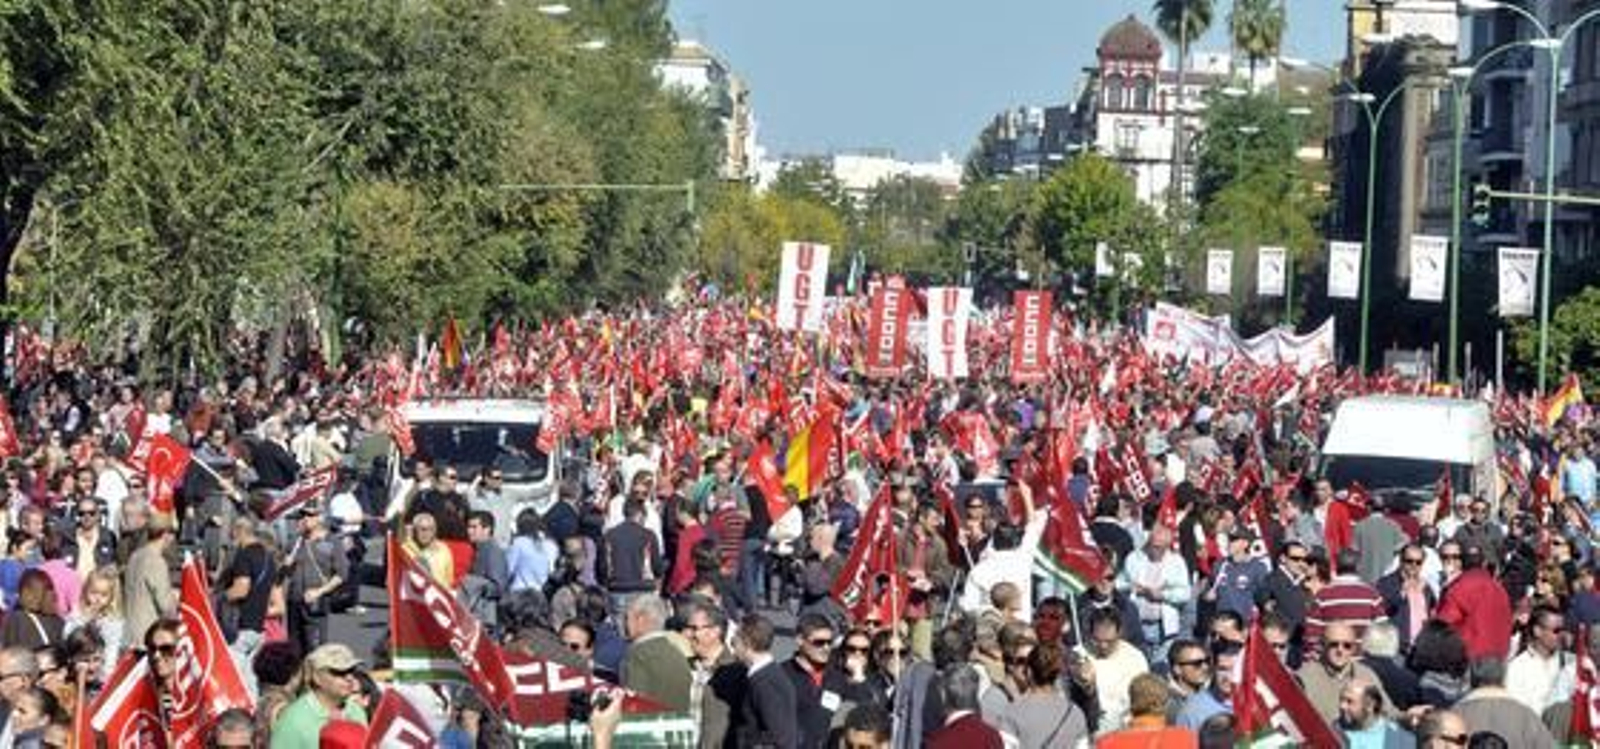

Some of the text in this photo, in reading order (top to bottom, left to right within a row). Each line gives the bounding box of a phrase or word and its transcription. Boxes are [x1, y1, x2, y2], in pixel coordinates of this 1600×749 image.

[793, 242, 814, 330] UGT
[879, 290, 899, 348] CCOO
[941, 288, 960, 374] UGT
[1024, 295, 1040, 351] CCOO
